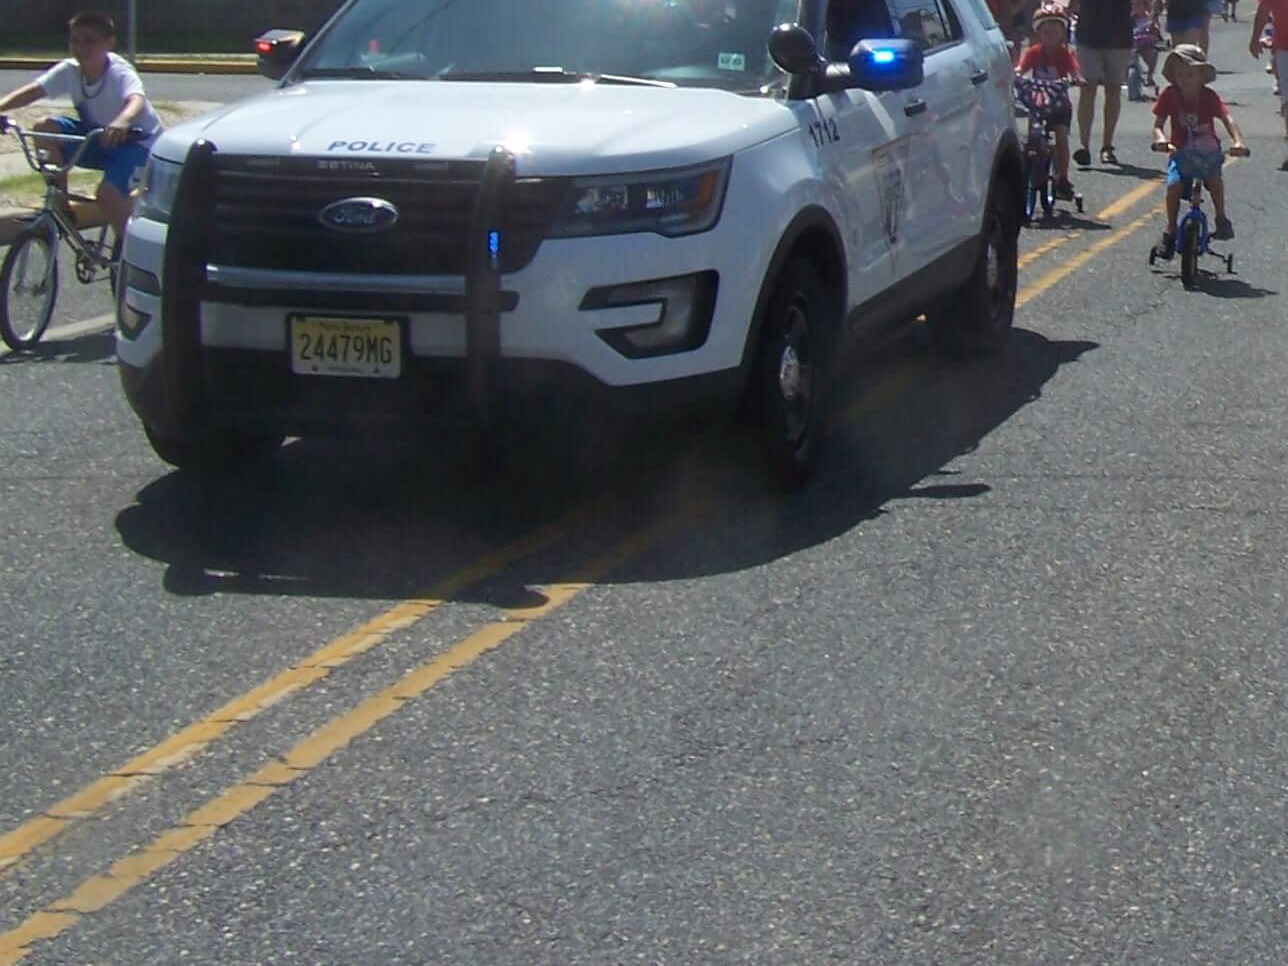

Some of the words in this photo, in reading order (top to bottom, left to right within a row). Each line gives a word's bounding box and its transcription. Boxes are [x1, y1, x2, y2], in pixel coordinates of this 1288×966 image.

[327, 140, 437, 154] POLICE
[808, 117, 841, 148] 1712
[299, 333, 393, 364] 24479MG
